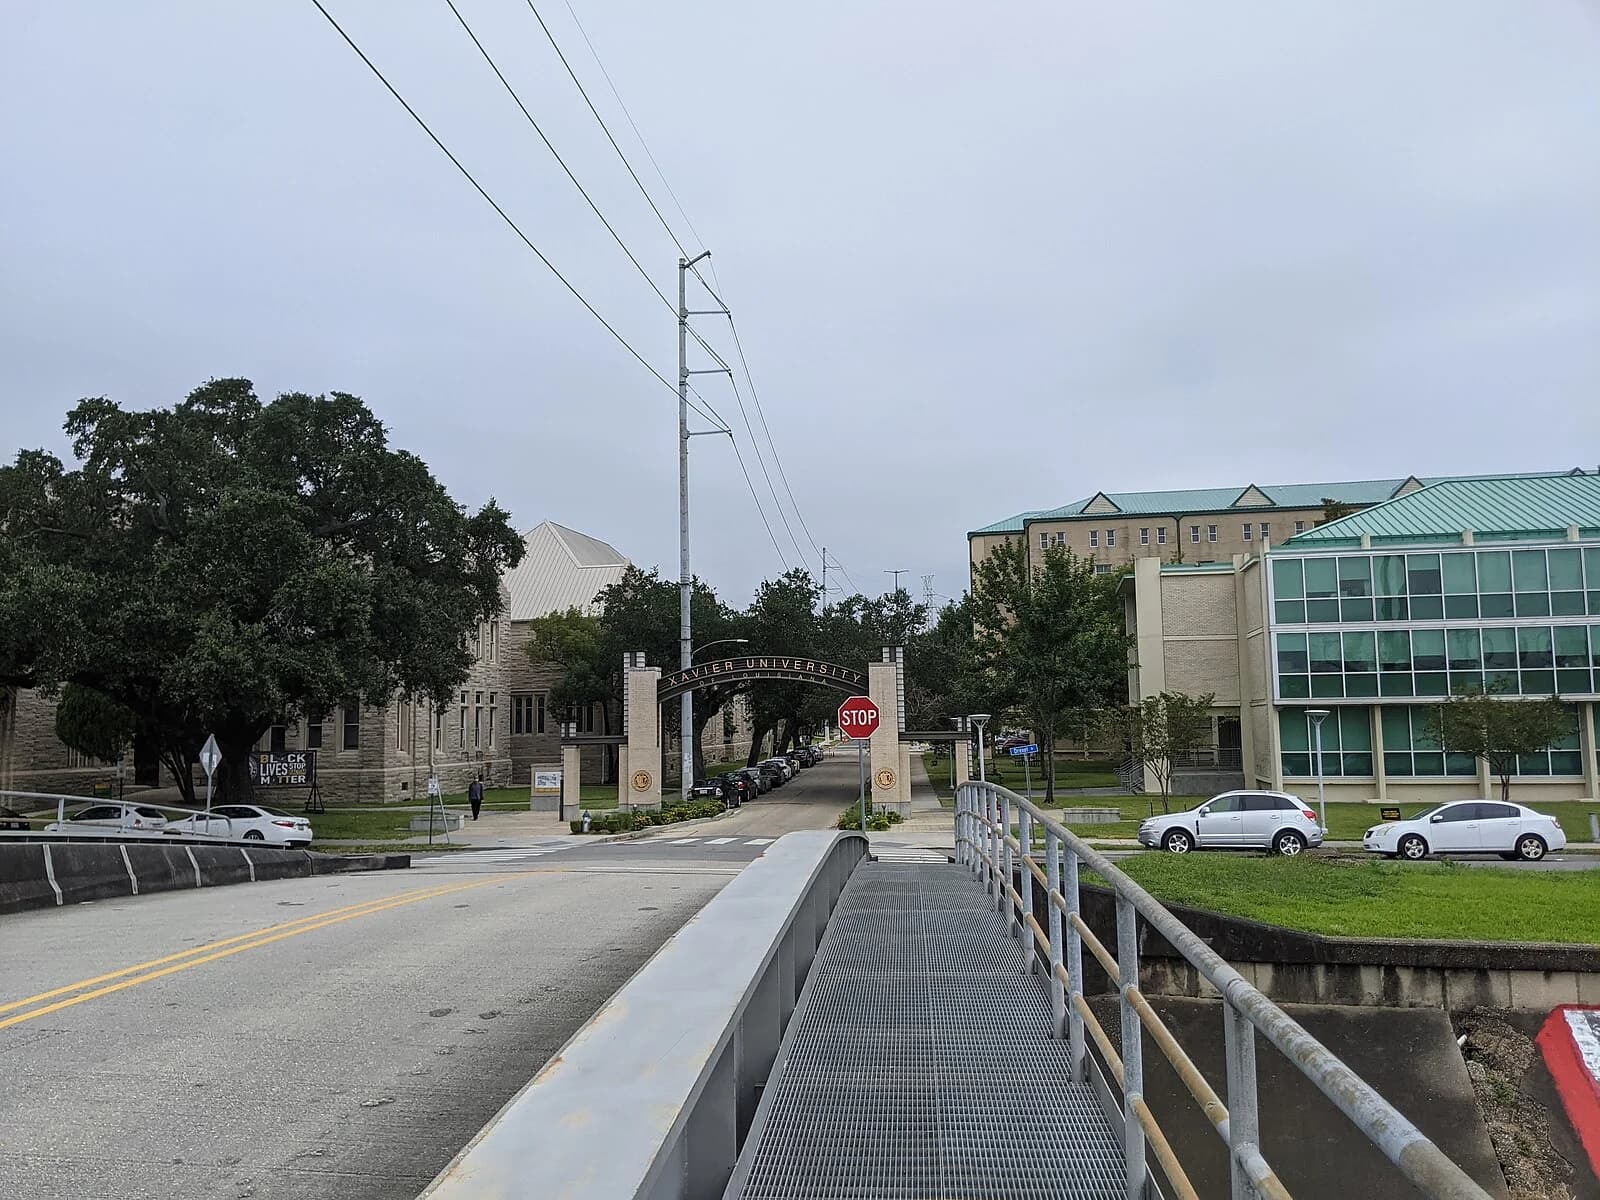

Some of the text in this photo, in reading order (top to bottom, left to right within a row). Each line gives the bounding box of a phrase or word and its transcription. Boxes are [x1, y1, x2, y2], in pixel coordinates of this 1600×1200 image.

[668, 659, 861, 687] XAVIER UNIVERSITY
[699, 671, 827, 687] OF LOUISIANA
[841, 709, 877, 726] STOP
[260, 754, 306, 763] BLCK
[260, 763, 288, 776] LIVES
[260, 775, 306, 785] MTTER
